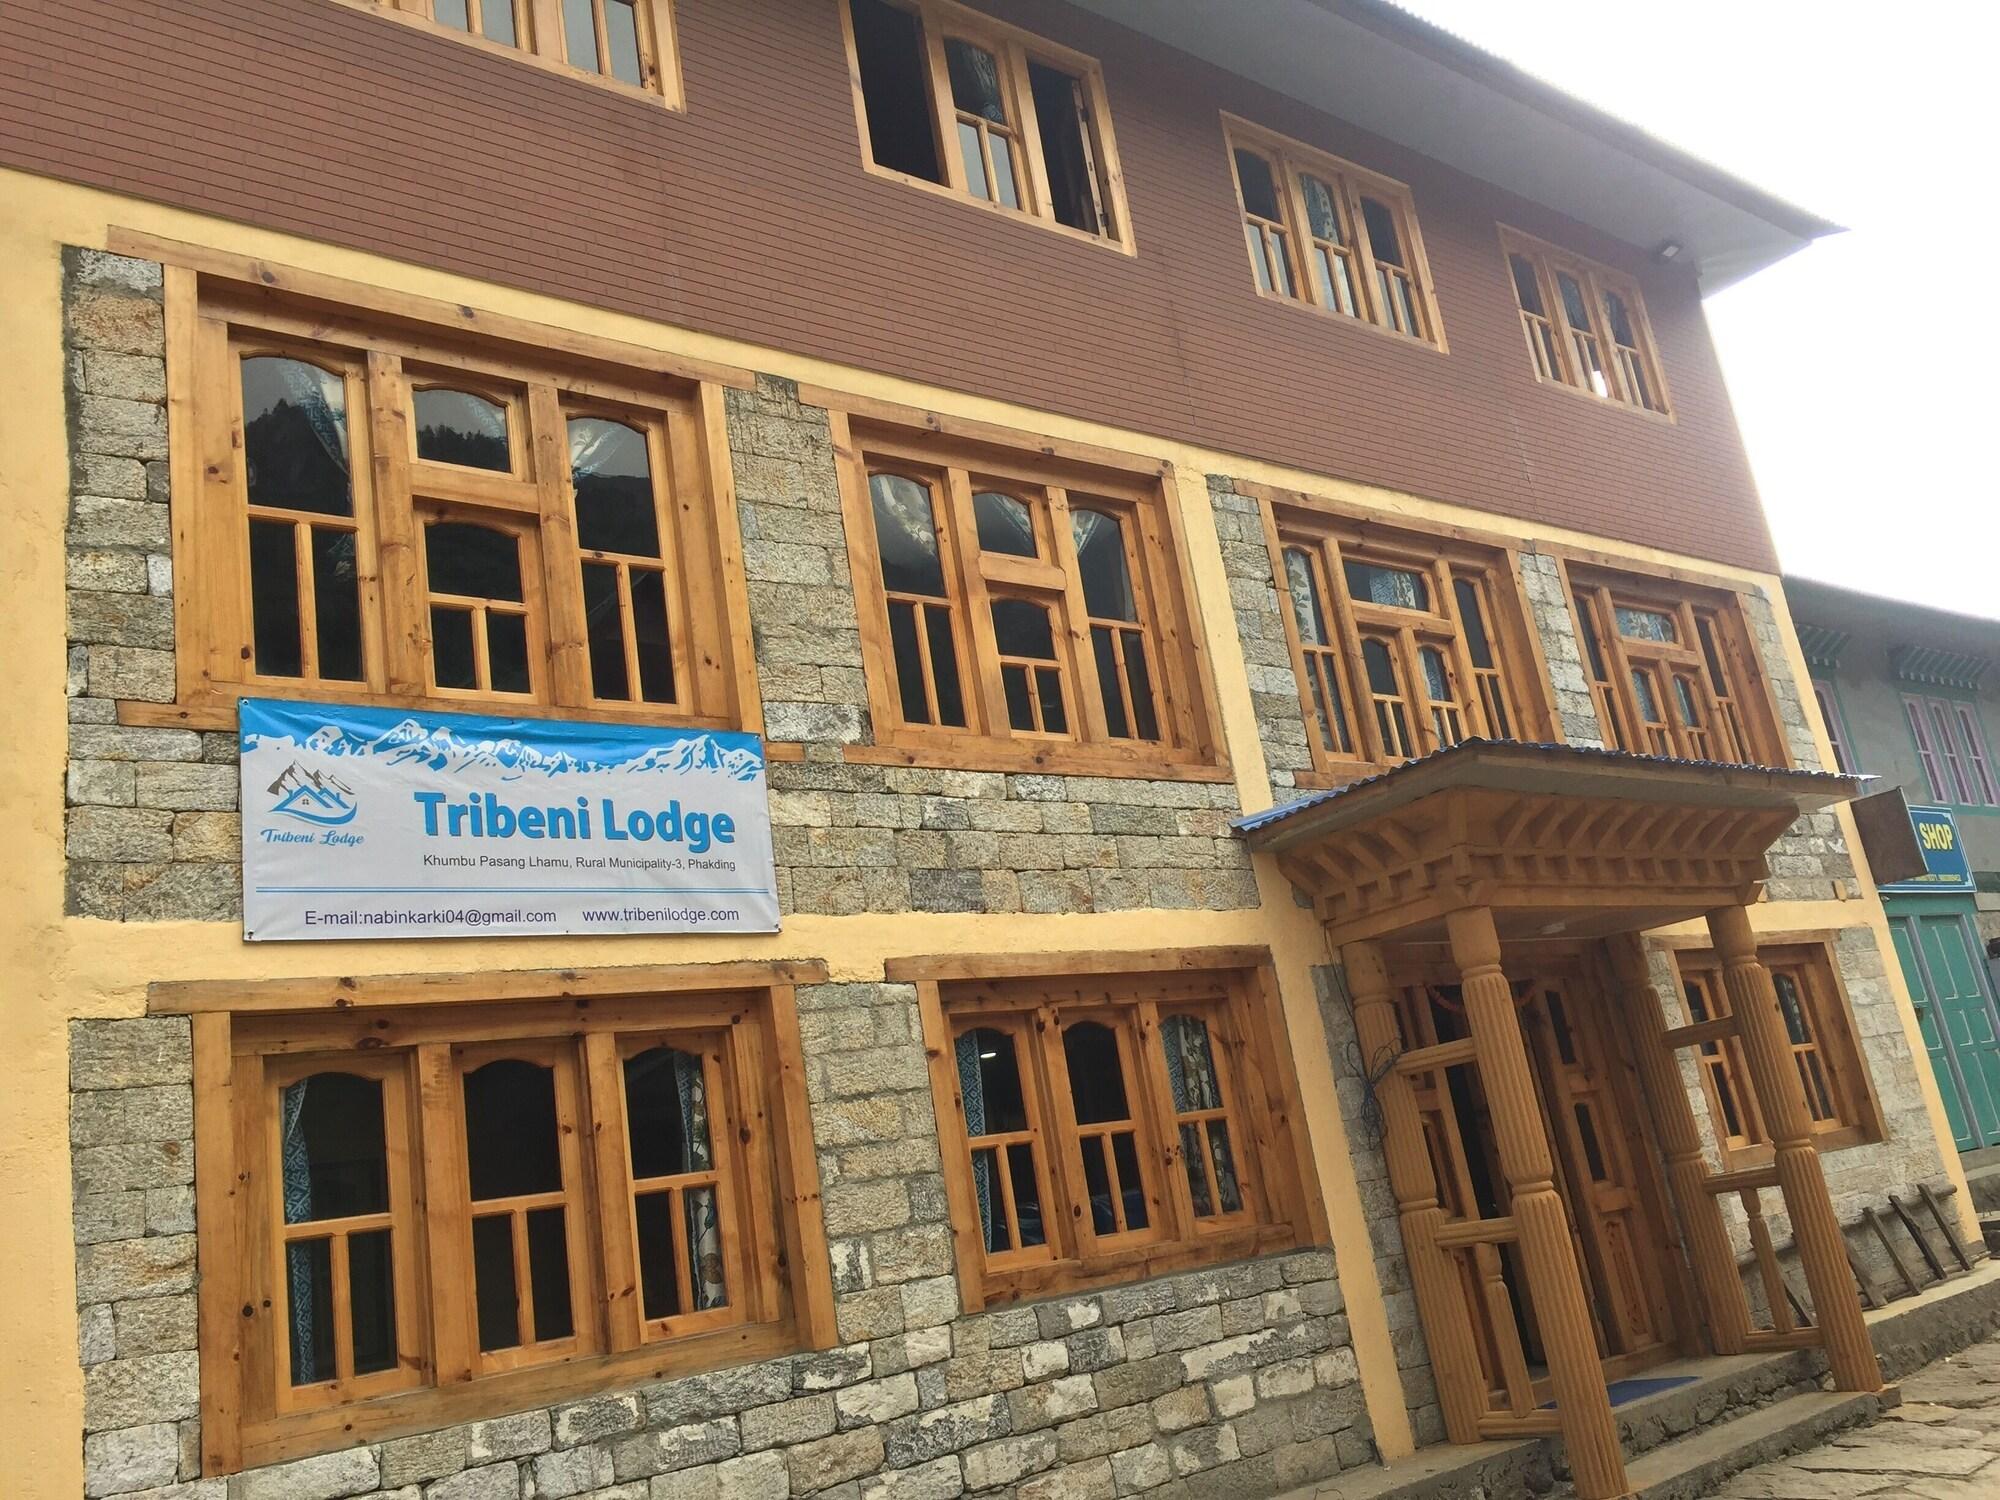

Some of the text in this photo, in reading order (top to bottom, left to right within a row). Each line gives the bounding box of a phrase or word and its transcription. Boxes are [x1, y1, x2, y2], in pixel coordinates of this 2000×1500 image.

[414, 792, 735, 853] Tribeni Lodge
[260, 828, 364, 847] Tribeni Lodge
[1919, 822, 1953, 850] SHOP
[423, 855, 736, 871] Khumbu Pasang Lhamu, Rural Municipality-3, Phakding
[305, 910, 557, 926] E-mail:nabinkarki04@gmail.com
[583, 907, 740, 924] www.tribenilodge.com
